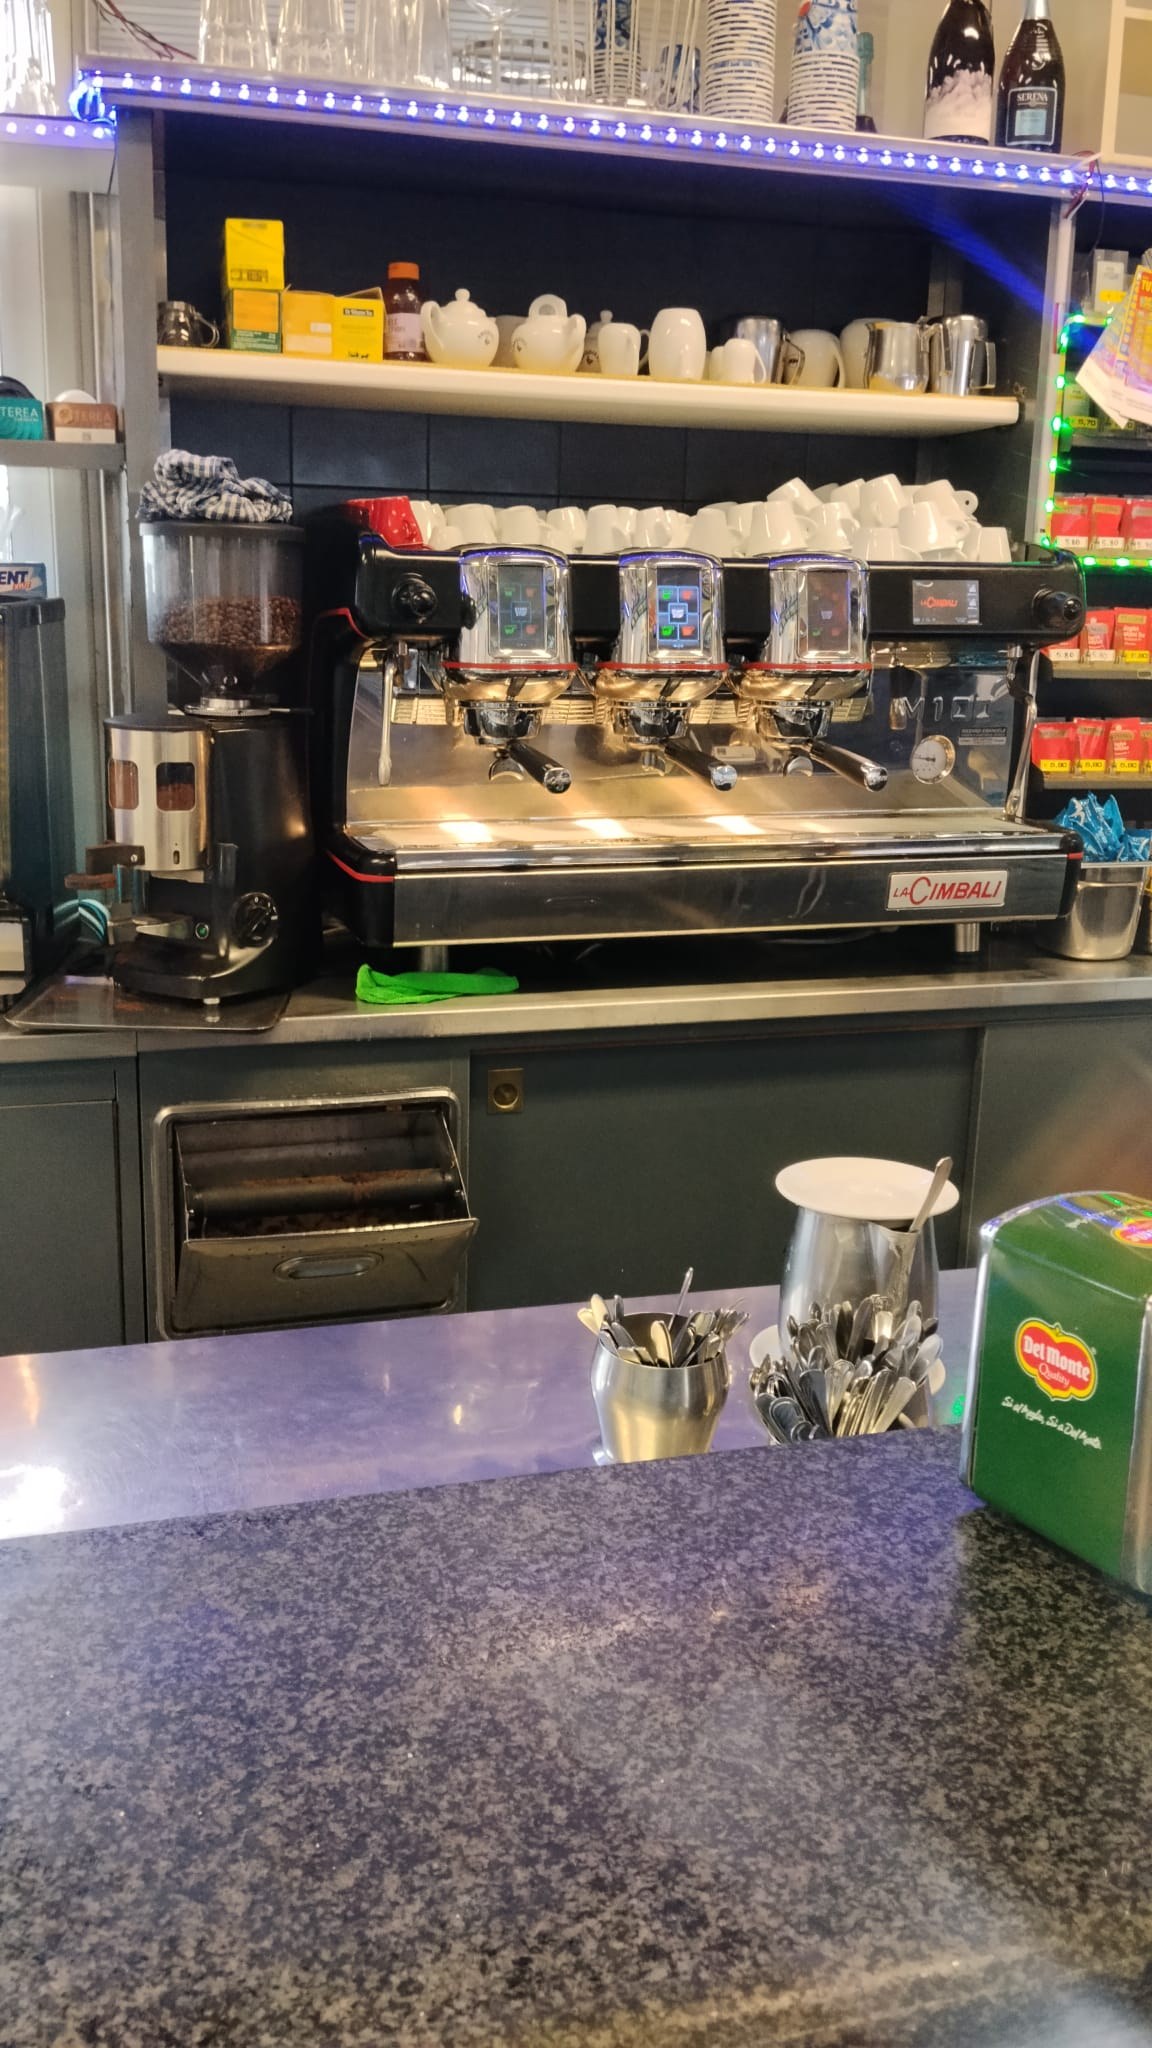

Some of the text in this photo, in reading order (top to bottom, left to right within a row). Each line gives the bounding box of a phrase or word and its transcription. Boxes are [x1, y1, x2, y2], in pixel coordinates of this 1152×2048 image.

[1016, 91, 1048, 102] SERENA
[0, 406, 39, 418] TEREA
[909, 876, 1002, 905] CIMBALI
[1023, 1335, 1090, 1382] Del Monte
[1039, 1363, 1071, 1389] Quality
